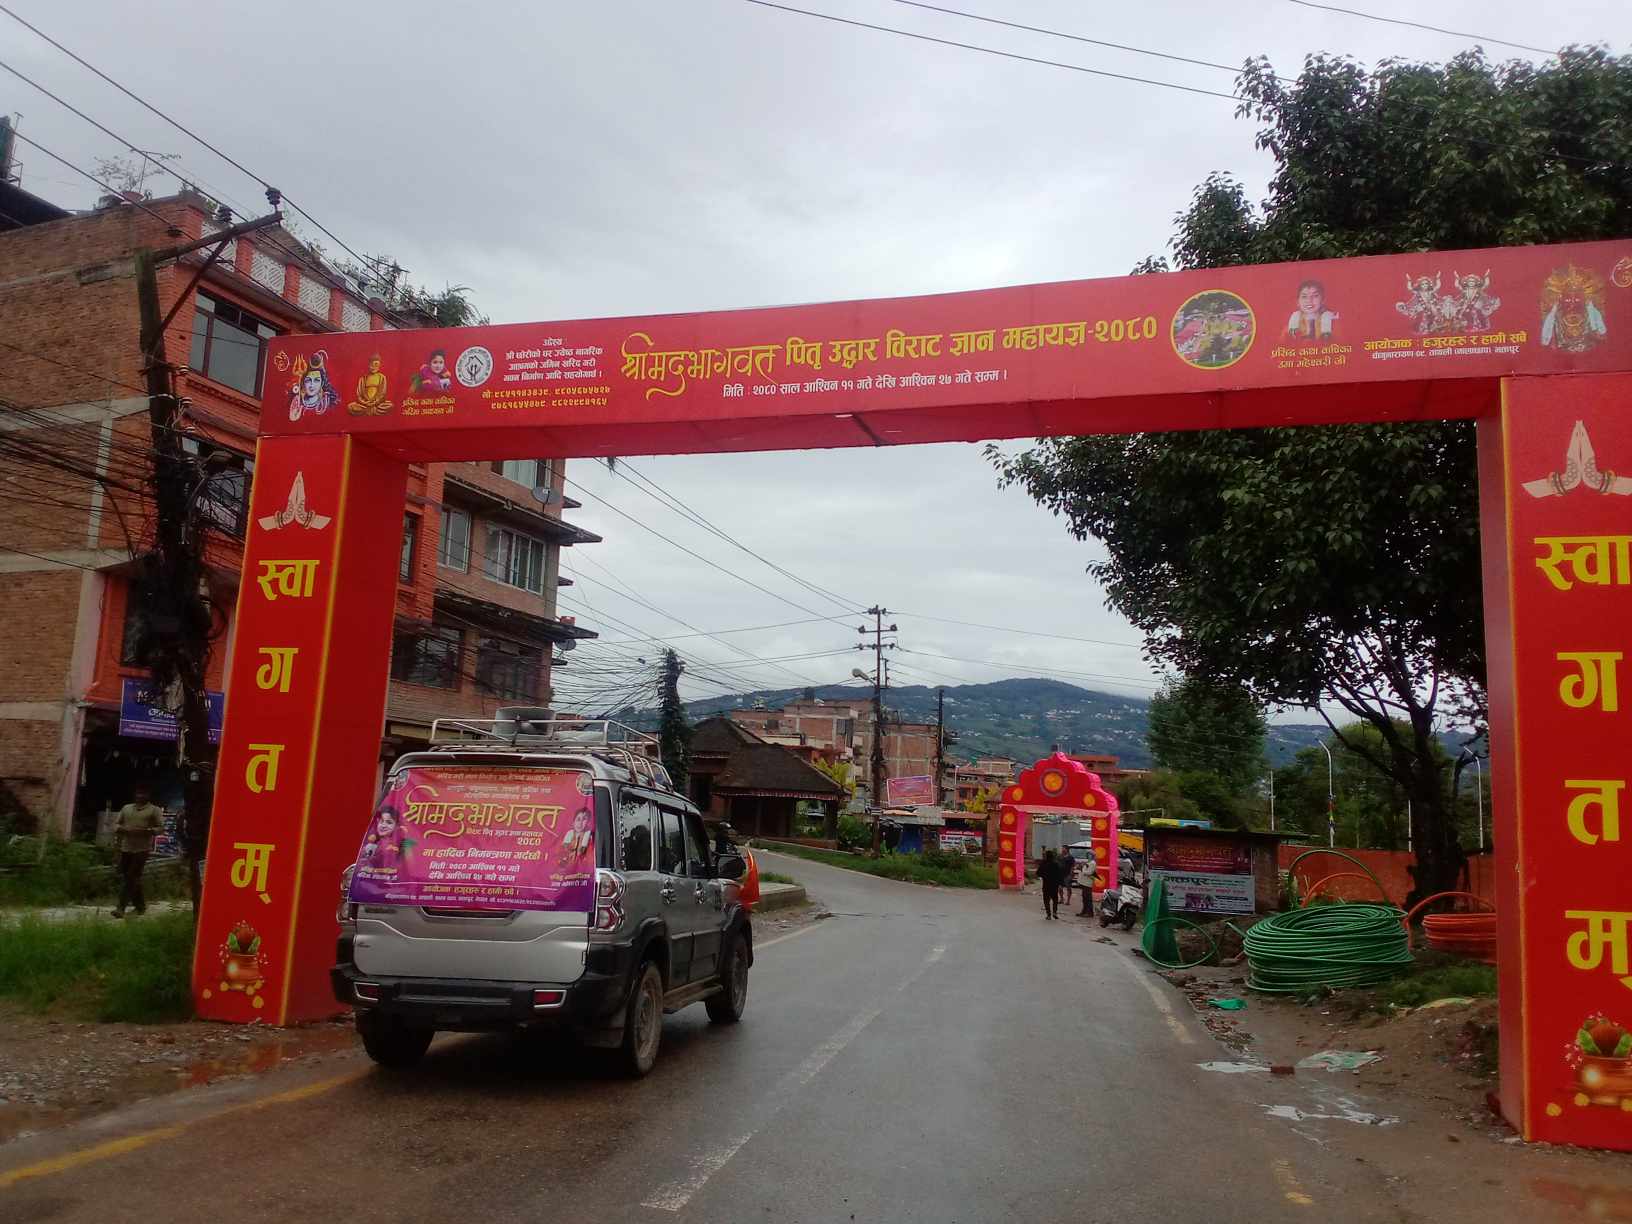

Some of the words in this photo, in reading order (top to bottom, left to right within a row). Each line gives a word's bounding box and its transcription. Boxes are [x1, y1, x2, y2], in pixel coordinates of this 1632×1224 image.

[786, 337, 823, 370] पितृ
[885, 328, 944, 359] विराट
[949, 328, 997, 357] ज्ञान
[752, 383, 777, 396] २०८०
[780, 382, 801, 395] साल
[803, 378, 839, 394] आश्विन
[841, 379, 855, 392] ११
[856, 376, 874, 391] गते
[875, 374, 897, 391] देखि
[899, 369, 936, 387] आश्विन
[938, 371, 953, 385] २७
[955, 369, 972, 384] गते
[974, 369, 1001, 384] सम्म
[516, 837, 542, 847] २०८०
